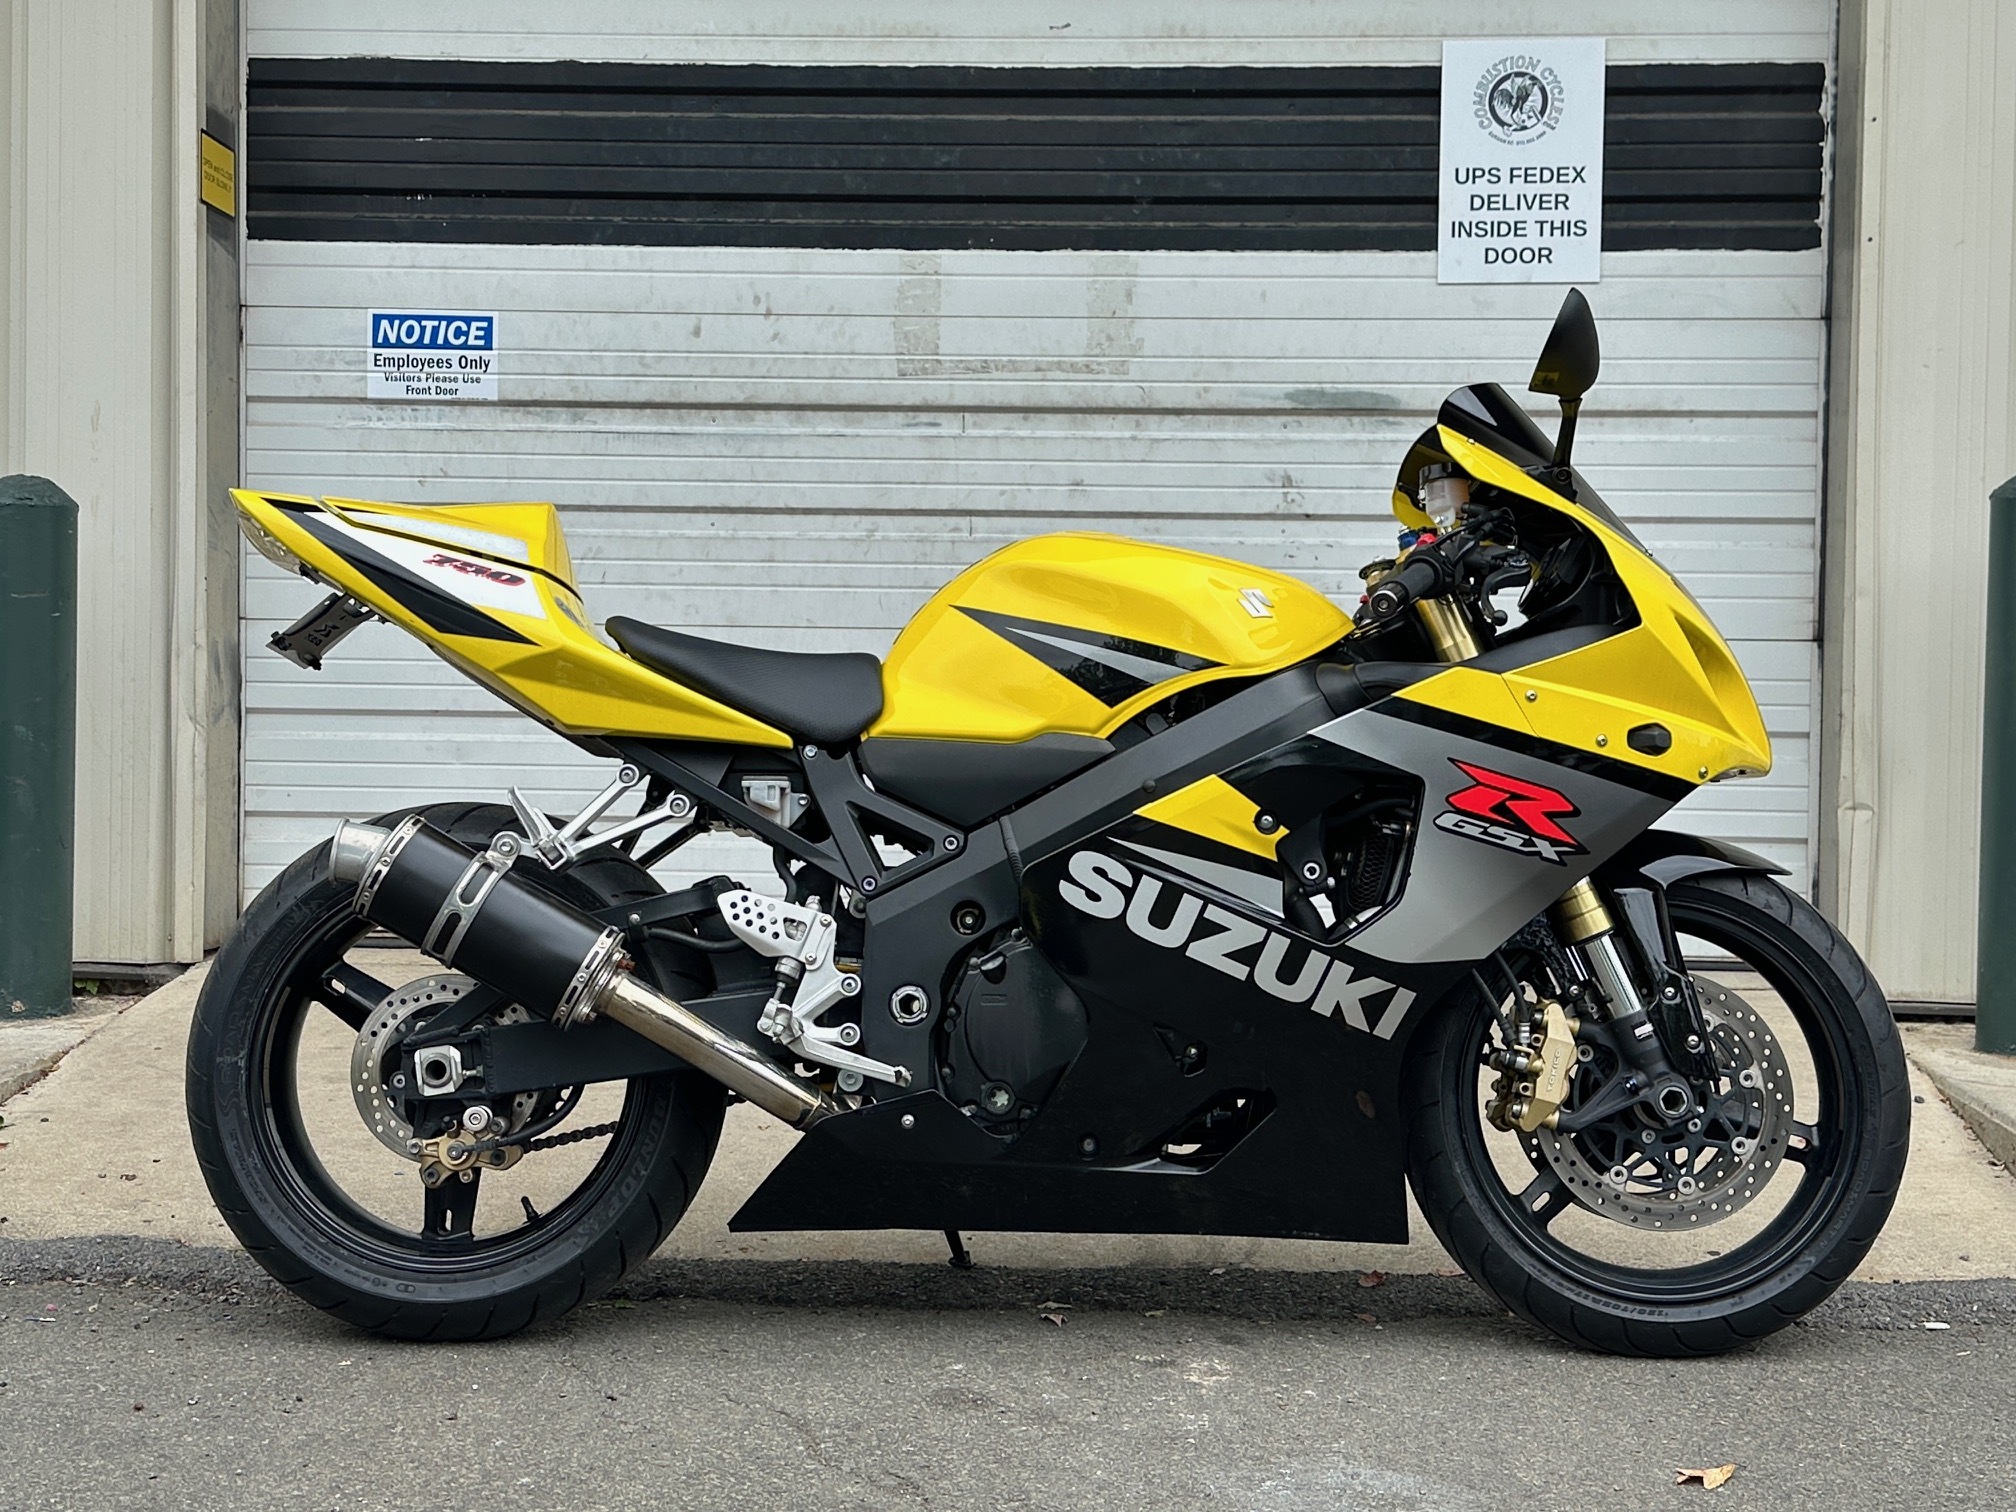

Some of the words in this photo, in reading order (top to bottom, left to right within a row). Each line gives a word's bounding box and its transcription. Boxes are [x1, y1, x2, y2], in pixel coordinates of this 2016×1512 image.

[1473, 55, 1541, 129] COMBUSTION
[1540, 67, 1564, 124] CYCLES
[1455, 167, 1501, 184] UPS
[1509, 166, 1586, 184] FEDEX
[1470, 194, 1569, 211] DELIVER
[1451, 220, 1527, 238] INSIDE
[1535, 219, 1588, 237] THIS
[1484, 247, 1553, 264] DOOR
[377, 319, 488, 346] NOTICE
[374, 353, 453, 372] Employees
[458, 355, 490, 373] Only
[384, 372, 422, 382] Visitors
[426, 373, 459, 383] Please
[462, 373, 481, 384] Use
[406, 385, 432, 395] Front
[435, 385, 459, 396] Door
[422, 553, 526, 587] 750
[1058, 850, 1417, 1041] SUZUKI
[1546, 1048, 1561, 1093] TOKICO
